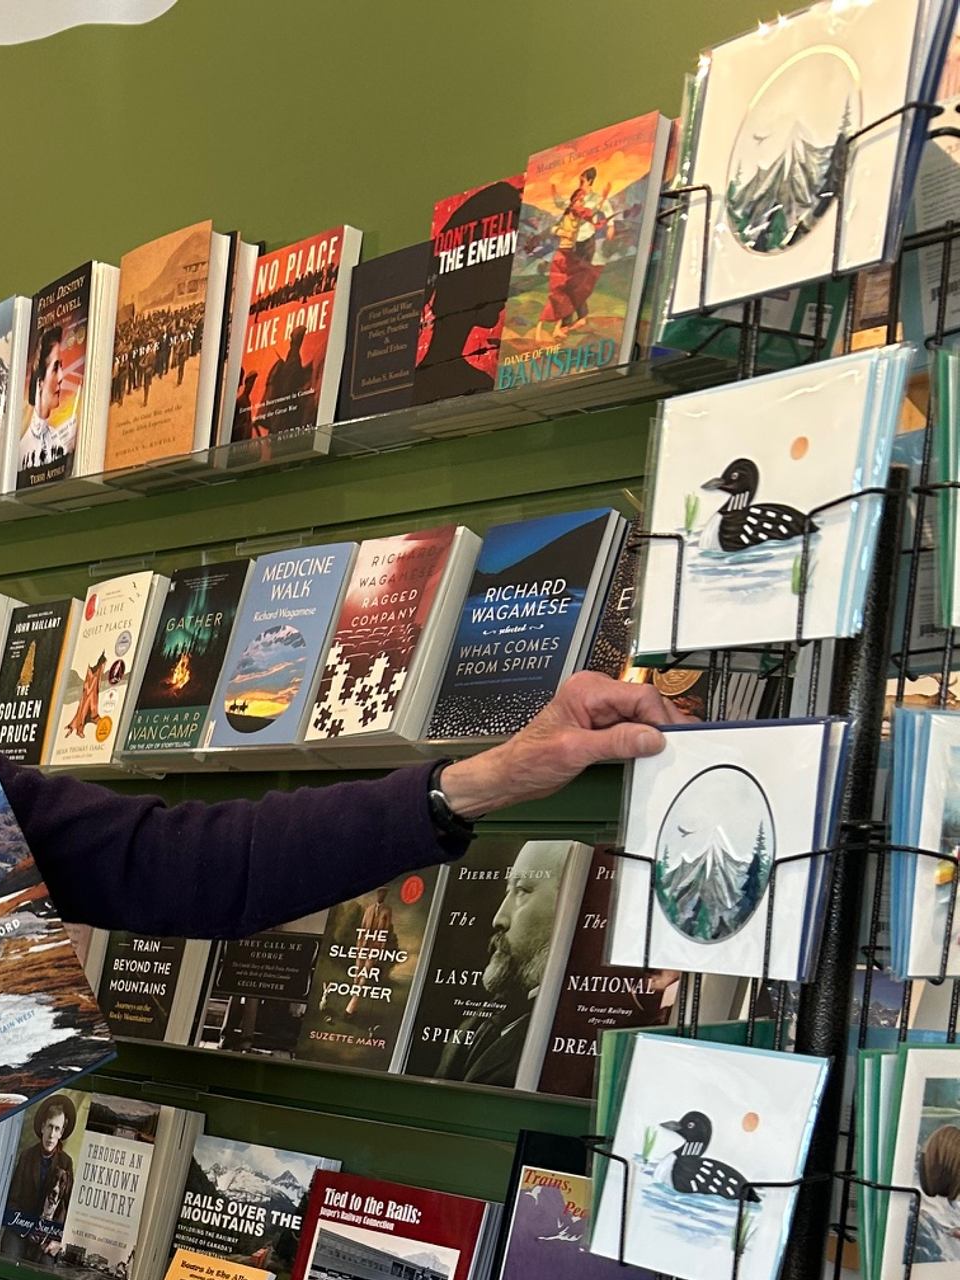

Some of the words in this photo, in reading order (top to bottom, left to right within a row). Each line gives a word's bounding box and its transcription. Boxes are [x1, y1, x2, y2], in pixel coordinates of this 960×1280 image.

[434, 221, 478, 257] DON'T
[482, 210, 514, 238] TELL
[439, 245, 464, 275] THE
[467, 229, 520, 267] ENEMY
[256, 259, 284, 296] NO
[286, 234, 339, 283] PLACE
[56, 296, 81, 318] CAVELL
[247, 317, 280, 353] LIKE
[284, 301, 329, 341] HOME
[115, 353, 129, 364] NO
[132, 341, 160, 360] FREE
[169, 329, 196, 347] MAN
[504, 351, 531, 366] DANCE
[532, 348, 543, 361] OF
[543, 342, 562, 358] THE
[497, 338, 616, 391] BANISHED
[262, 555, 335, 583] MEDICINE
[270, 579, 313, 601] WALK
[360, 589, 418, 609] RAGGED
[484, 578, 568, 604] RICHARD
[110, 602, 124, 614] THE
[253, 608, 278, 623] Richard
[278, 605, 317, 621] Wagamese
[350, 606, 417, 628] COMPANY
[471, 597, 572, 624] WAGAMESE
[14, 619, 30, 634] JOHN
[30, 616, 62, 632] VAILLANT
[83, 625, 103, 639] QUIET
[105, 619, 133, 632] PLACES
[167, 612, 224, 633] GATHER
[498, 624, 528, 636] selected
[459, 642, 500, 659] WHAT
[504, 636, 561, 655] COMES
[456, 661, 498, 676] FROM
[503, 654, 553, 672] SPIRIT
[16, 684, 30, 696] THE
[137, 712, 201, 724] RICHARD
[133, 725, 159, 741] VAN
[159, 723, 198, 741] CAMP
[448, 912, 477, 926] The
[583, 913, 608, 929] The
[356, 928, 389, 942] THE
[133, 939, 161, 953] TRAIN
[250, 951, 283, 960] GEORGE
[329, 945, 408, 963] SLEEPING
[113, 959, 151, 973] BEYOND
[153, 961, 172, 976] THE
[347, 966, 380, 983] CAR
[434, 968, 483, 986] LAST
[109, 979, 167, 996] MOUNTAINS
[327, 982, 393, 1003] PORTER
[567, 975, 656, 995] NATIONAL
[16, 1009, 36, 1025] WEST
[309, 1030, 354, 1044] SUZETTE
[355, 1037, 386, 1050] MAYR
[421, 1026, 475, 1047] SPIKE
[87, 1143, 126, 1167] THROUGH
[129, 1151, 144, 1169] AN
[82, 1163, 141, 1190] UNKNOWN
[523, 1168, 573, 1195] Trains,
[77, 1184, 136, 1218] COUNTRY
[184, 1191, 225, 1212] RAILS
[227, 1201, 267, 1223] OVER
[271, 1210, 302, 1231] THE
[324, 1187, 349, 1209] Tied
[349, 1193, 363, 1212] to
[363, 1196, 384, 1216] the
[385, 1200, 422, 1225] Rails:
[180, 1205, 265, 1237] MOUNTAINS
